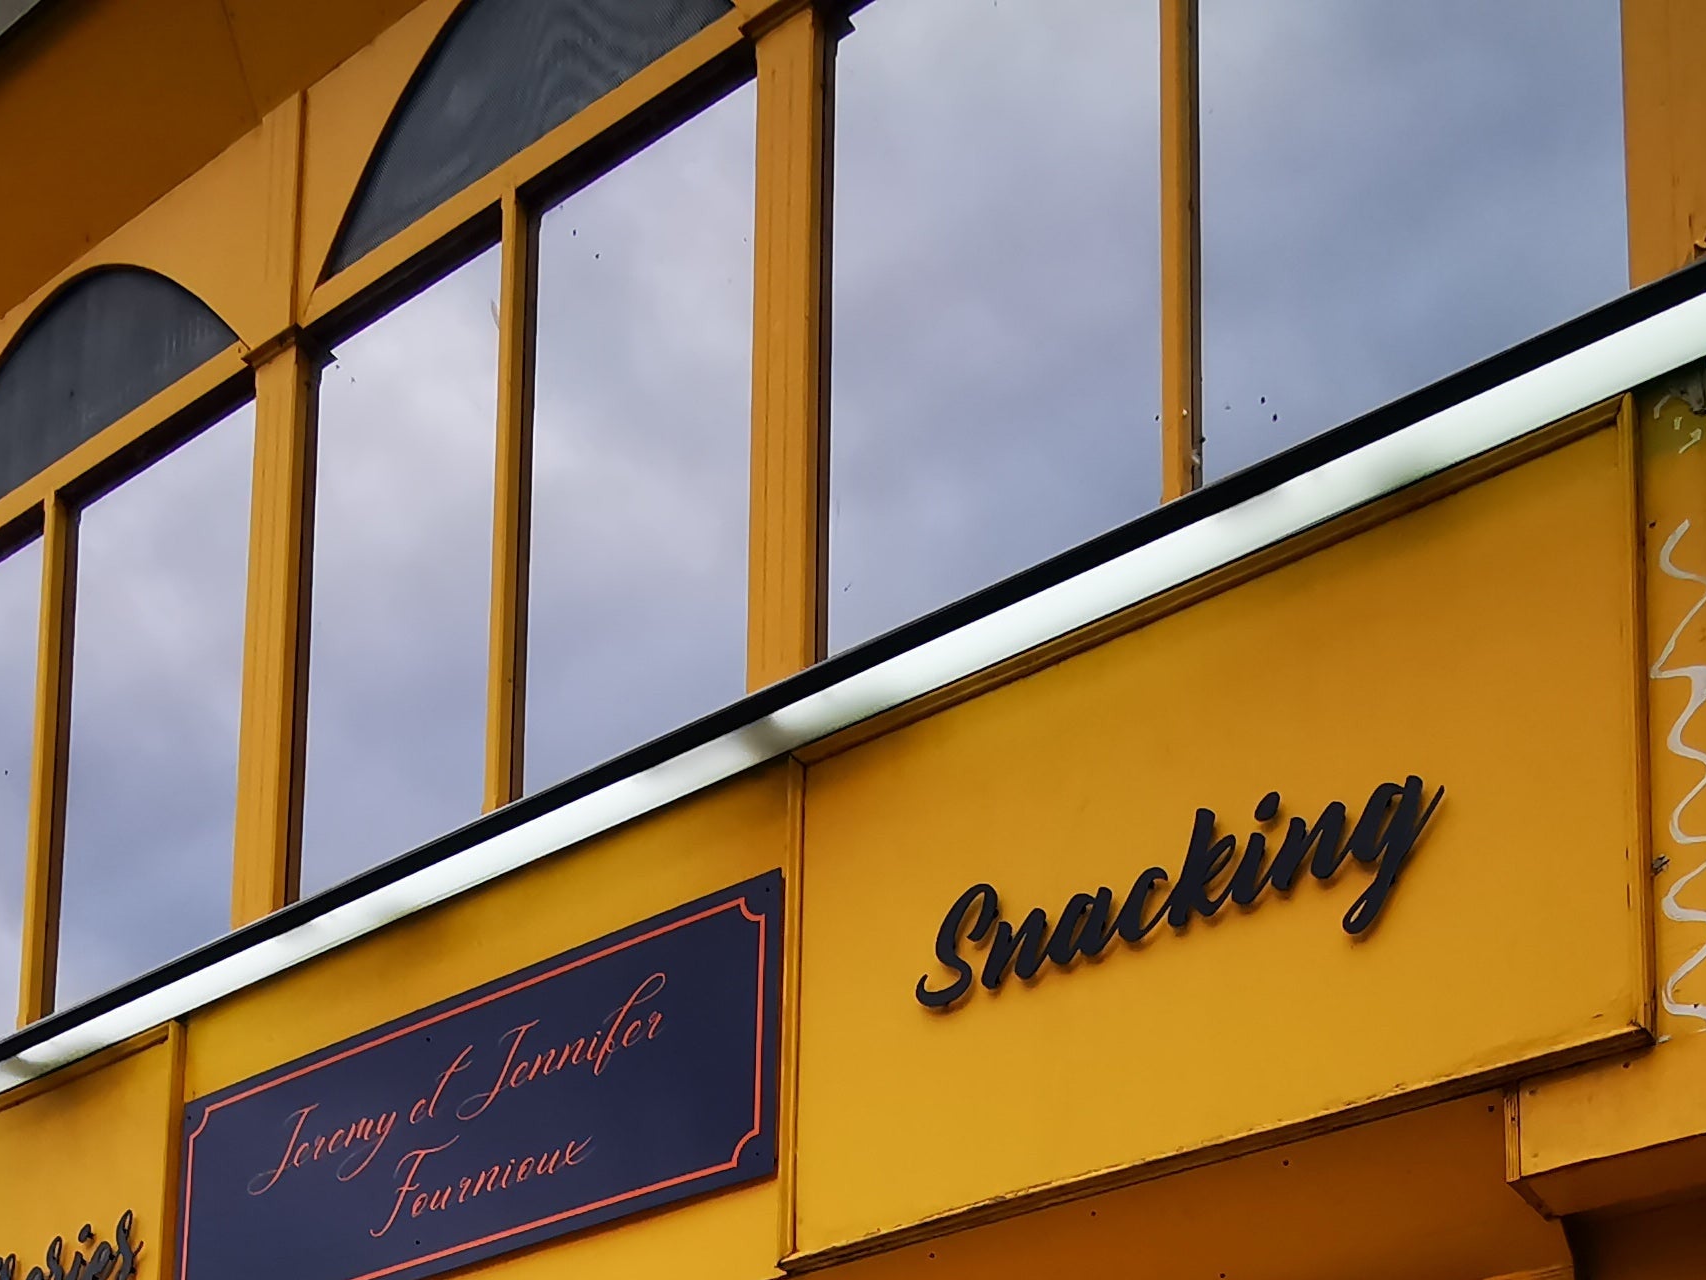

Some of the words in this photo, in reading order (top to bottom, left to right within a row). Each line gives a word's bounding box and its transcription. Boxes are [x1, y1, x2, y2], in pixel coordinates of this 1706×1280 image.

[915, 774, 1445, 1008] Snacking
[247, 1103, 397, 1195] Jeremy
[409, 1045, 473, 1124] et
[455, 972, 666, 1120] Jennifer
